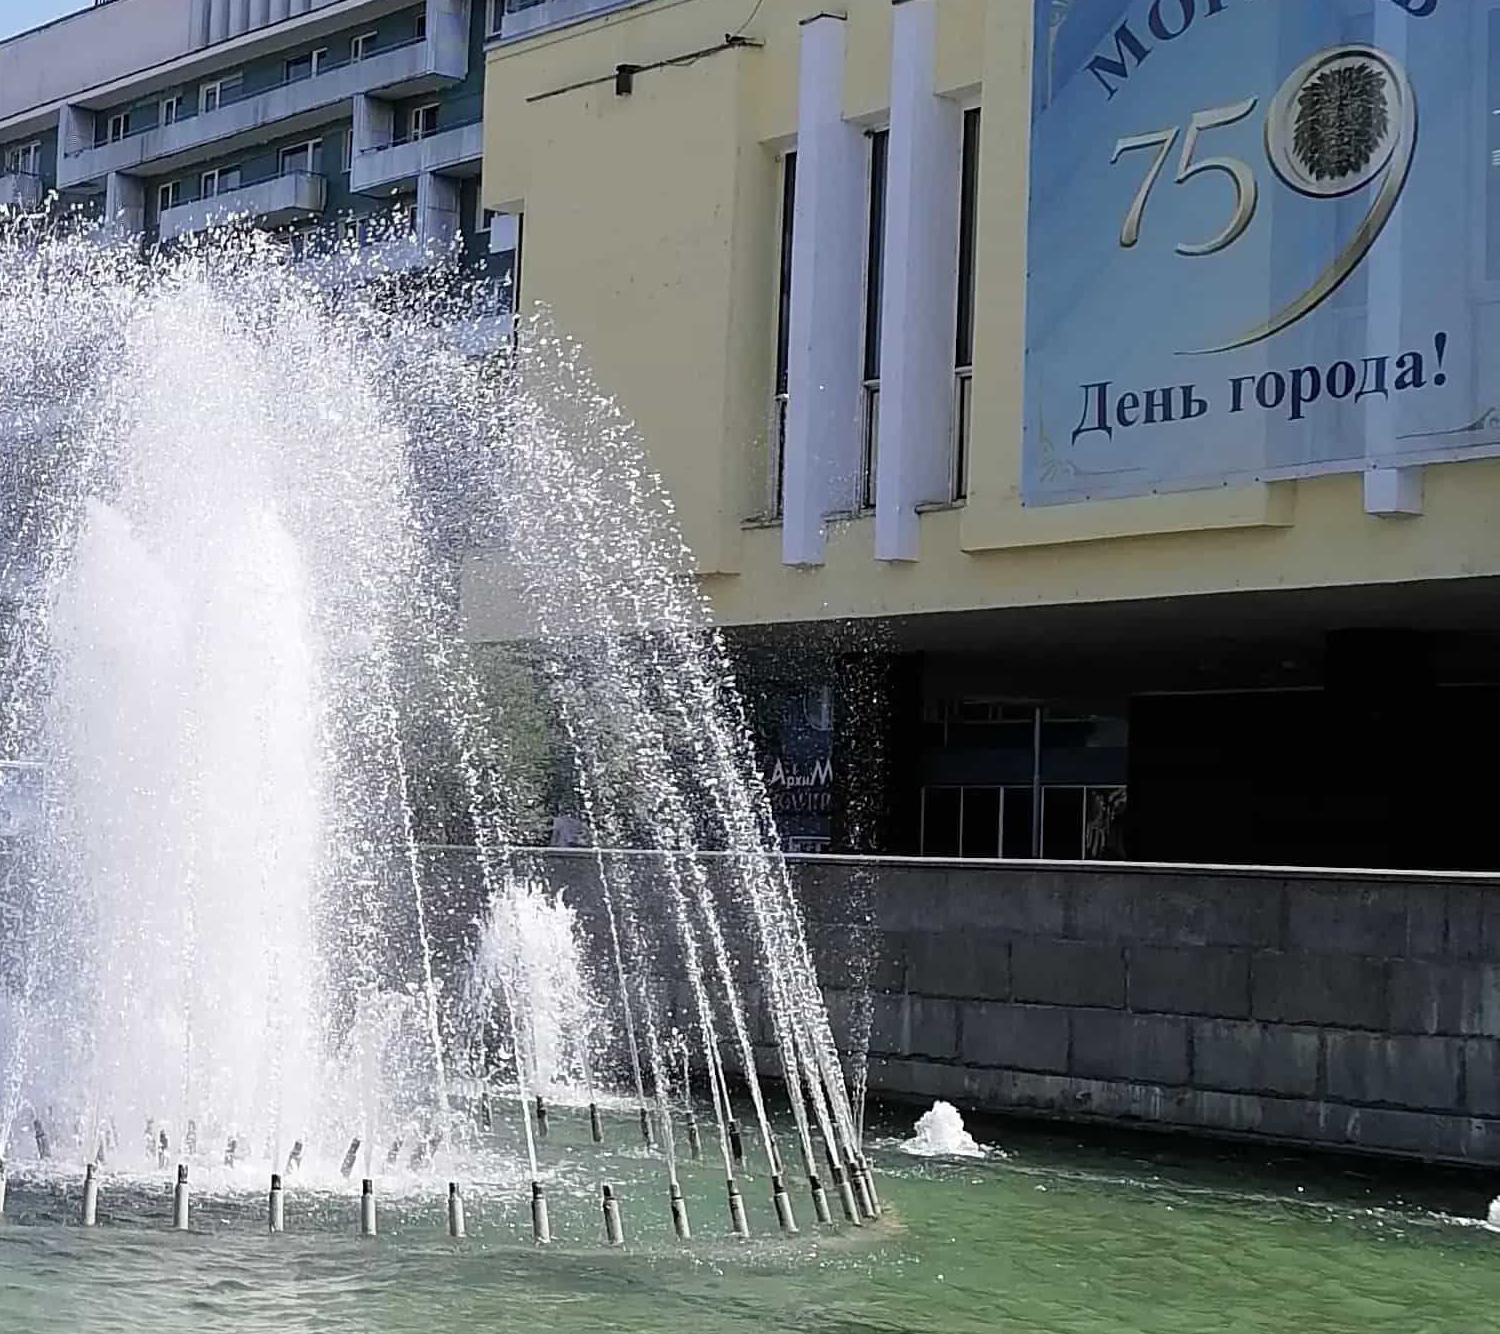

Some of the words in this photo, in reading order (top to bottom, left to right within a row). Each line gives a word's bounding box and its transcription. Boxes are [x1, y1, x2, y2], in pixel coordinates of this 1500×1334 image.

[1110, 41, 1420, 356] 759
[1071, 379, 1208, 447] День
[1227, 331, 1449, 421] города!
